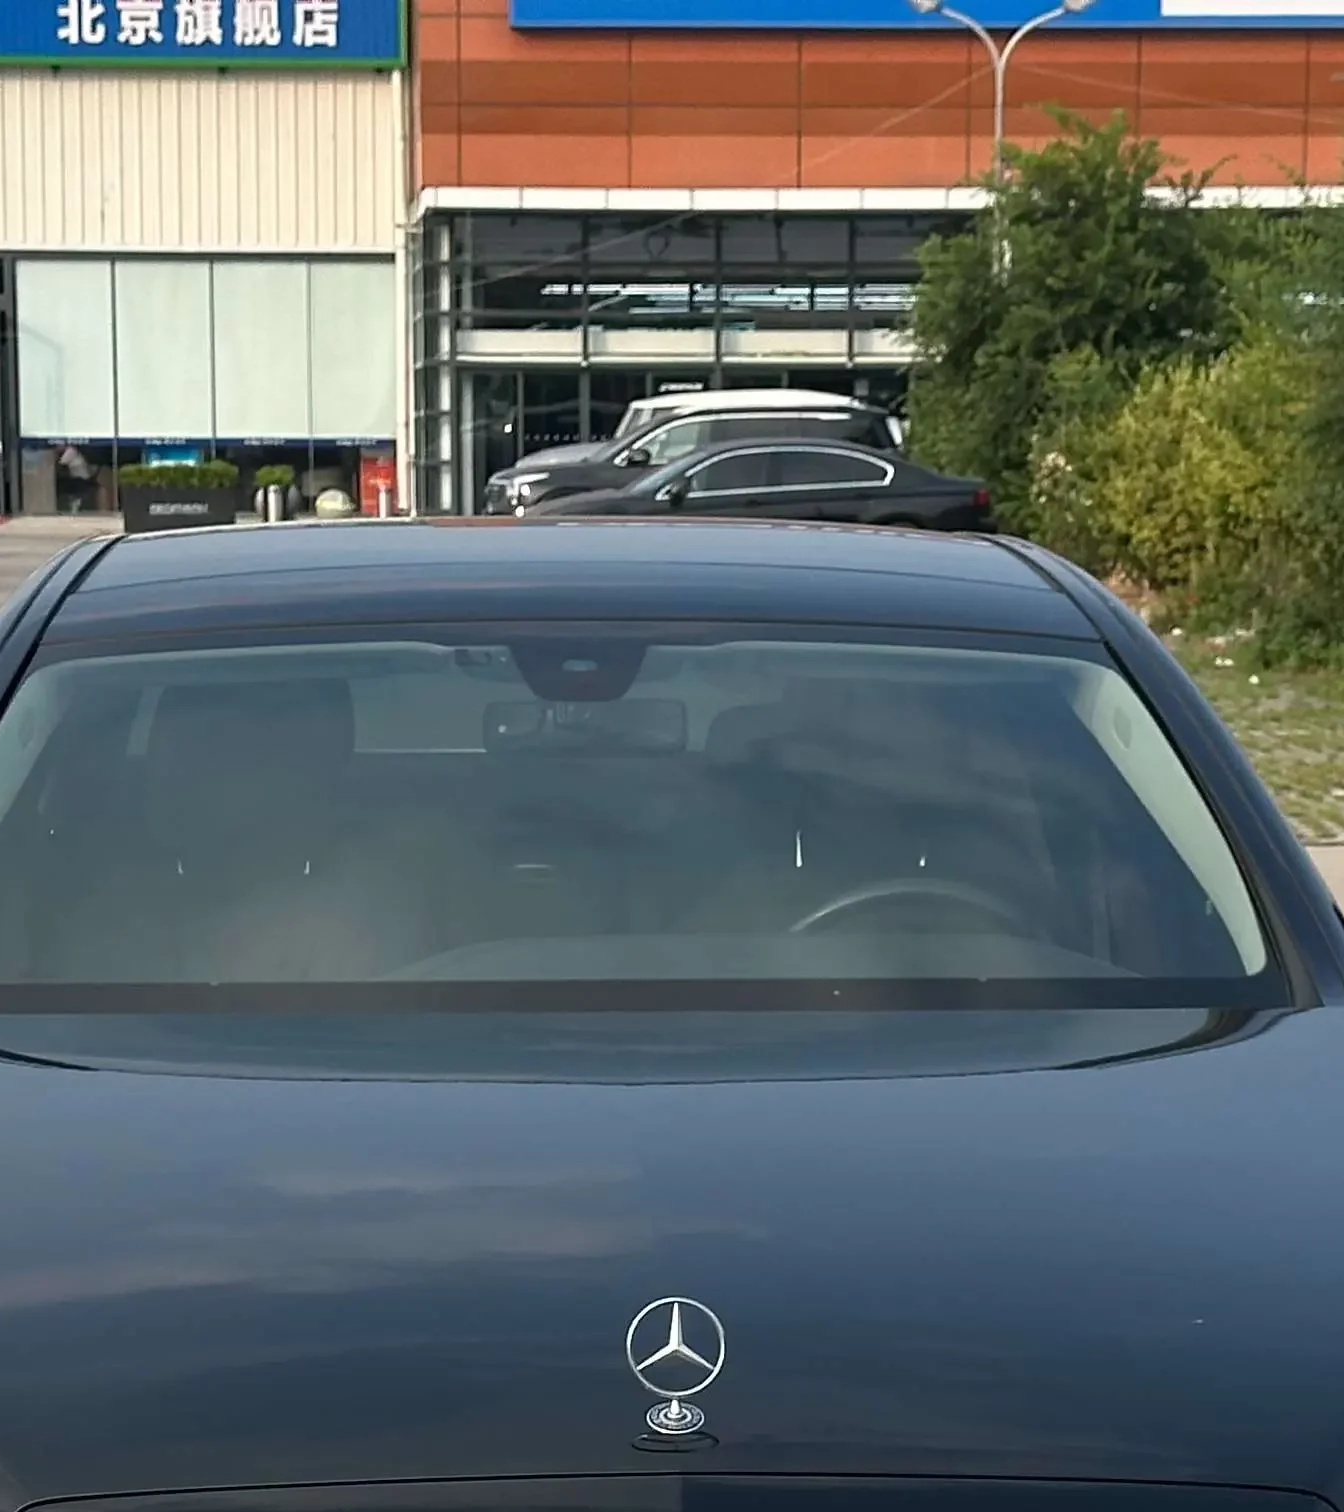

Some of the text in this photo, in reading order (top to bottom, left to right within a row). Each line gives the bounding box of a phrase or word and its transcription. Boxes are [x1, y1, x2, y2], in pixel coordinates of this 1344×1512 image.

[57, 0, 339, 47] 北京旗舰店
